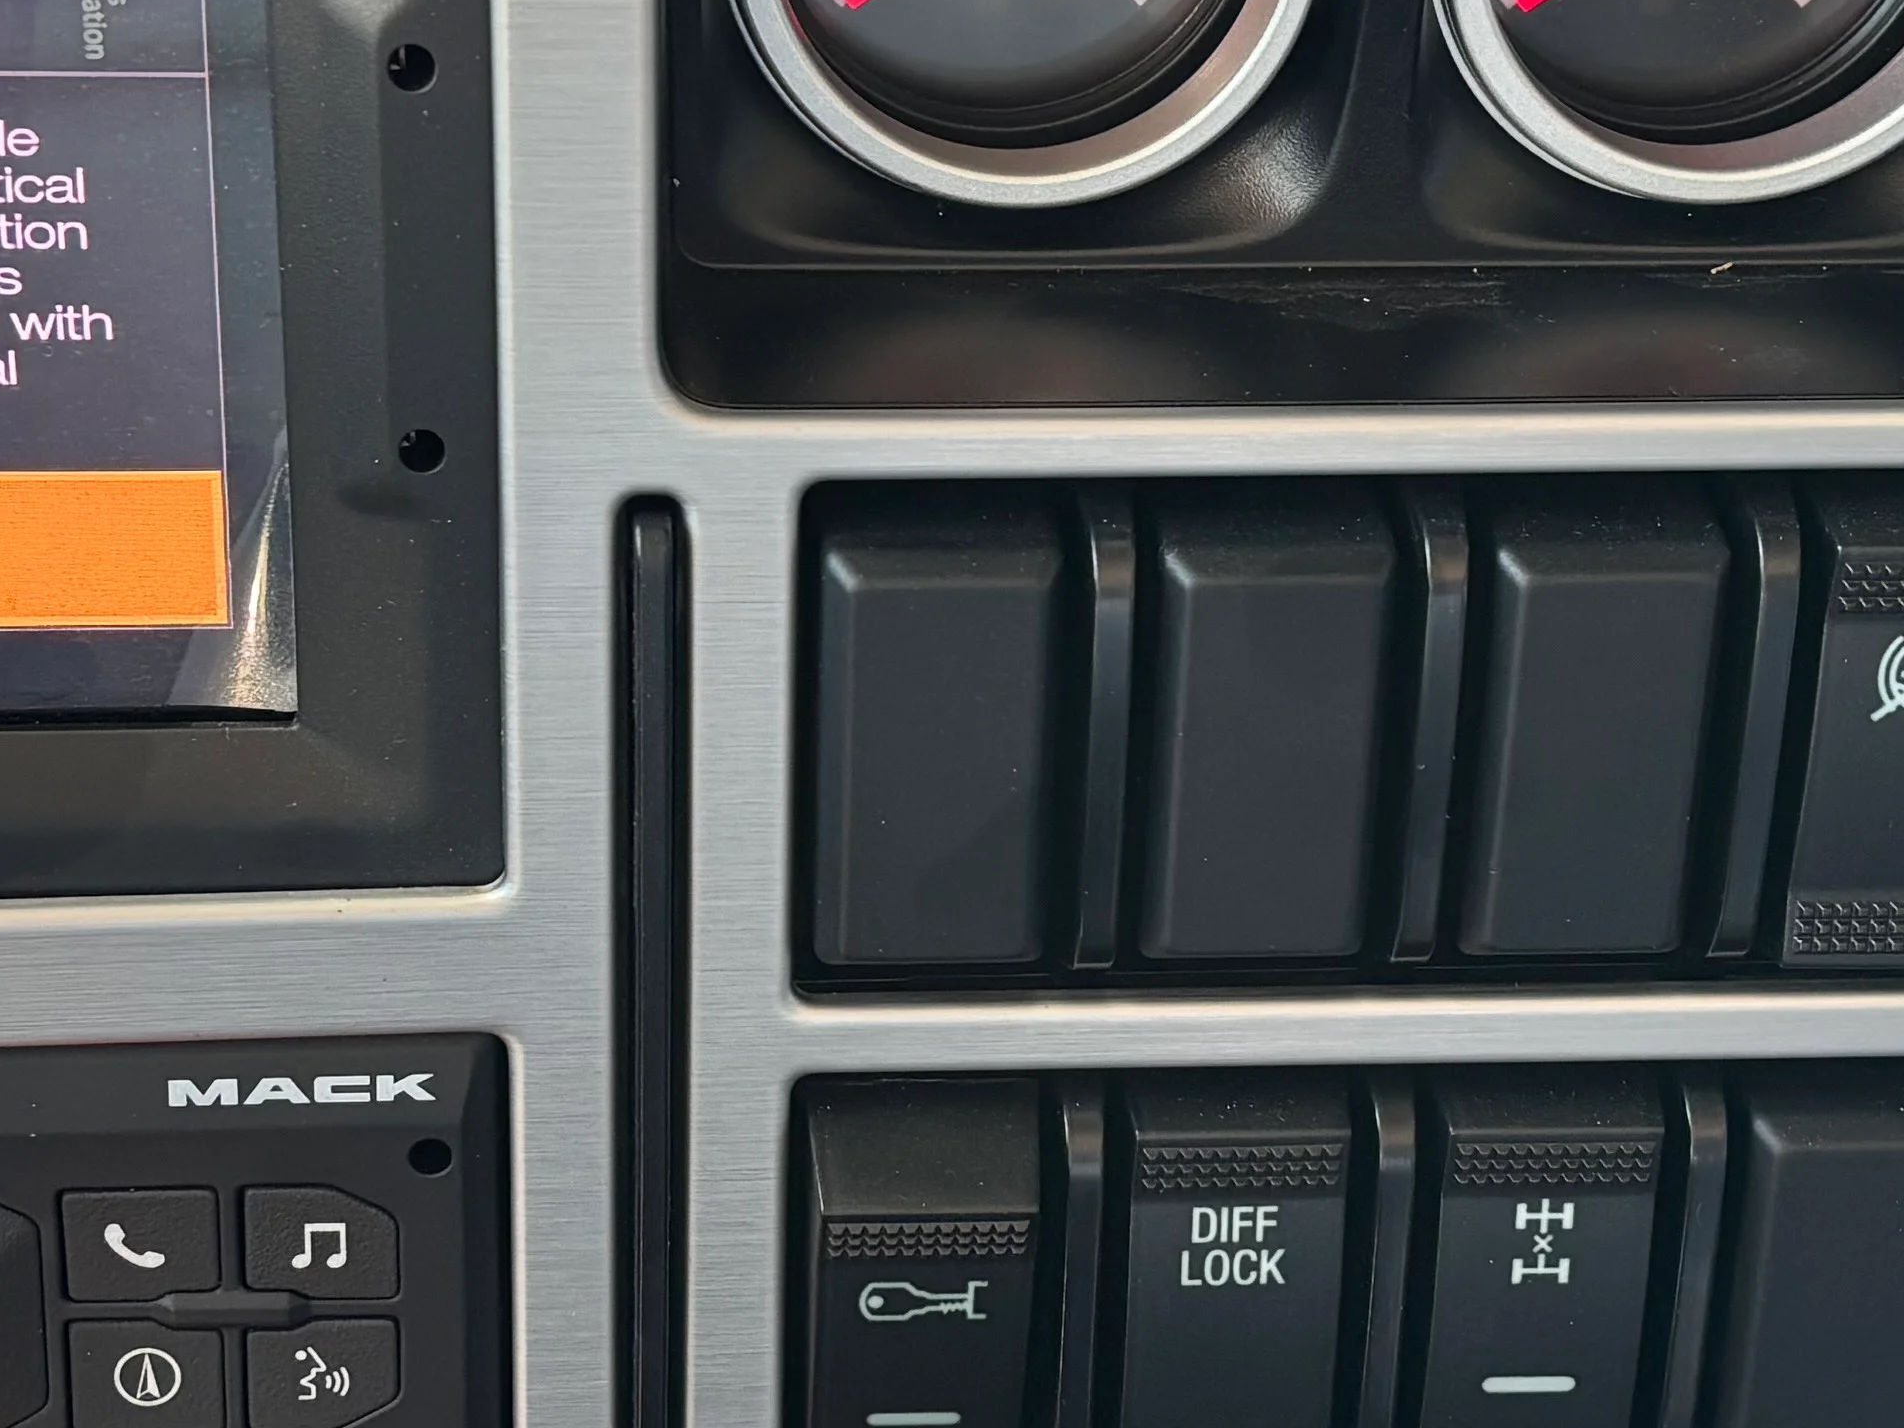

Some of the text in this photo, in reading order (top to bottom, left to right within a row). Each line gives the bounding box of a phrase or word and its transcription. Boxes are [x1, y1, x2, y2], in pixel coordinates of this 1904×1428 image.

[9, 304, 114, 341] with
[167, 1073, 436, 1107] MACK
[1191, 1205, 1279, 1244] DIFF
[1180, 1248, 1285, 1286] LOCK
